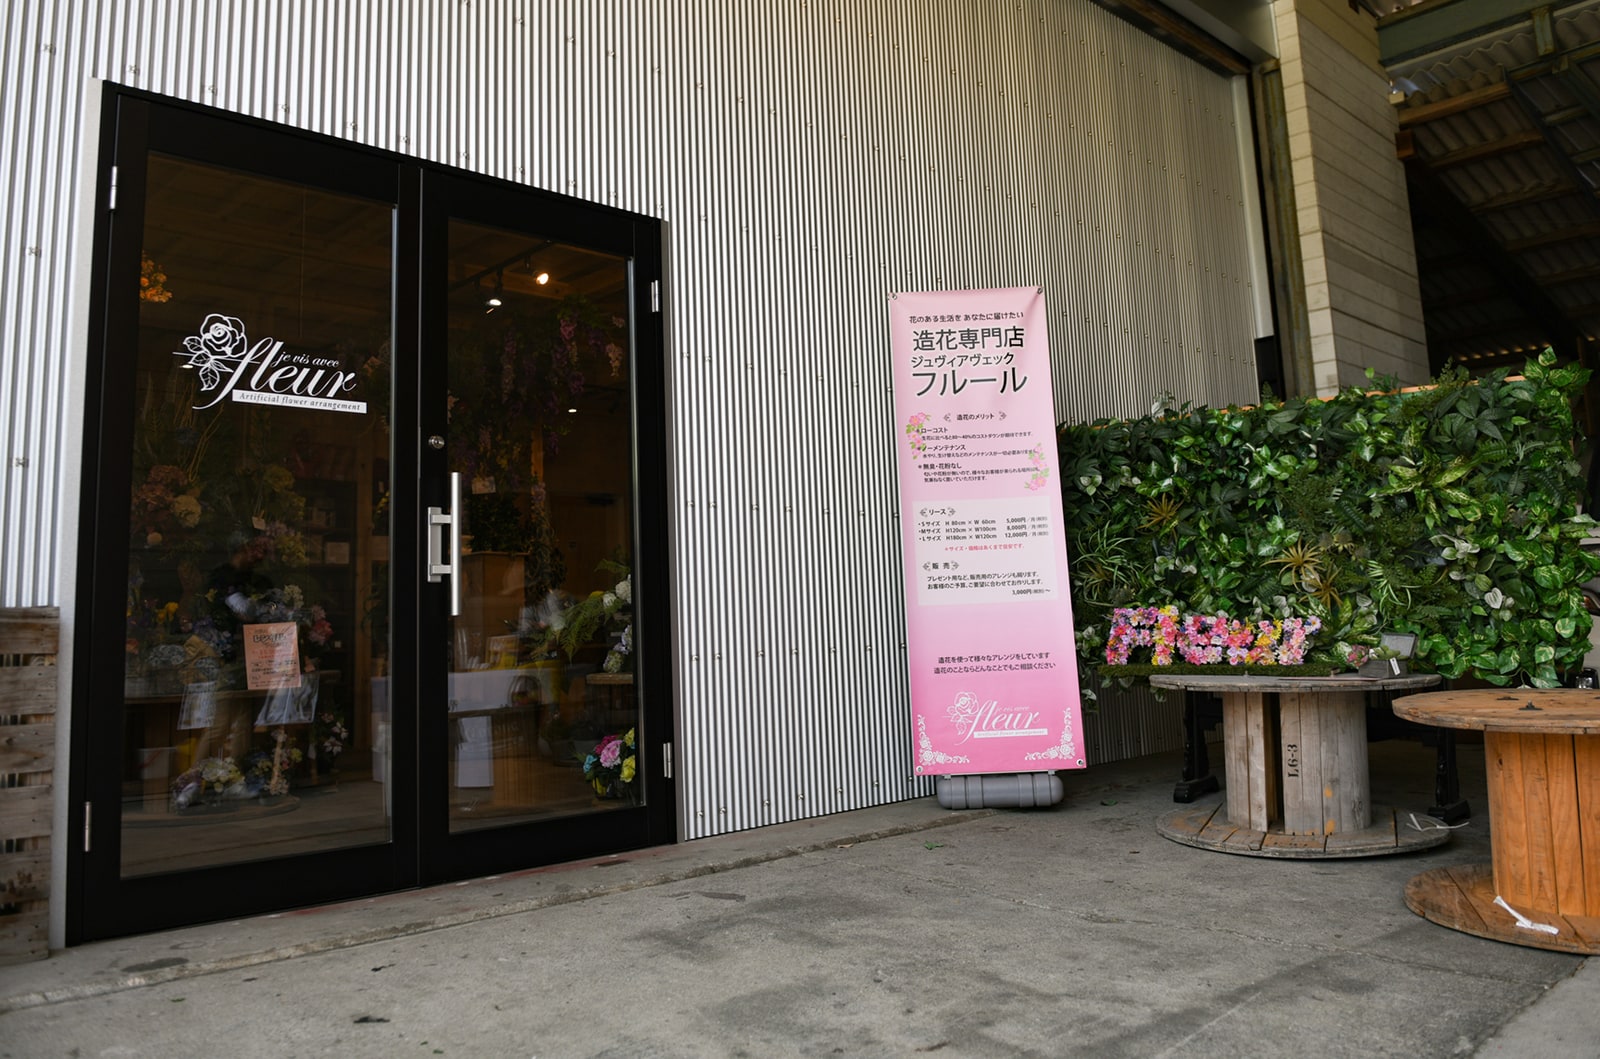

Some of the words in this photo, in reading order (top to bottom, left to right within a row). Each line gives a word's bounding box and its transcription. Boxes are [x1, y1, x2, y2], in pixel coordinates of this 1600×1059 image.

[909, 314, 962, 324] 花のある生活を
[964, 312, 1024, 321] あなたに届けたい
[913, 325, 1025, 351] 造花専門店
[272, 351, 291, 367] je
[293, 354, 310, 365] vis
[312, 357, 340, 368] avec
[911, 352, 1015, 369] ジュヴィアヴェック
[192, 336, 357, 410] fleur
[912, 366, 1028, 397] フルール
[239, 392, 280, 403] Artificial
[281, 394, 308, 406] flower
[309, 399, 361, 411] arrangement
[956, 412, 995, 421] 造花のメリット
[922, 444, 966, 452] ノーメンテナンス
[938, 652, 1050, 664] 造花を使って様々なアレンジをしています
[954, 699, 1041, 746] fleur
[1287, 743, 1299, 778] L6-3
